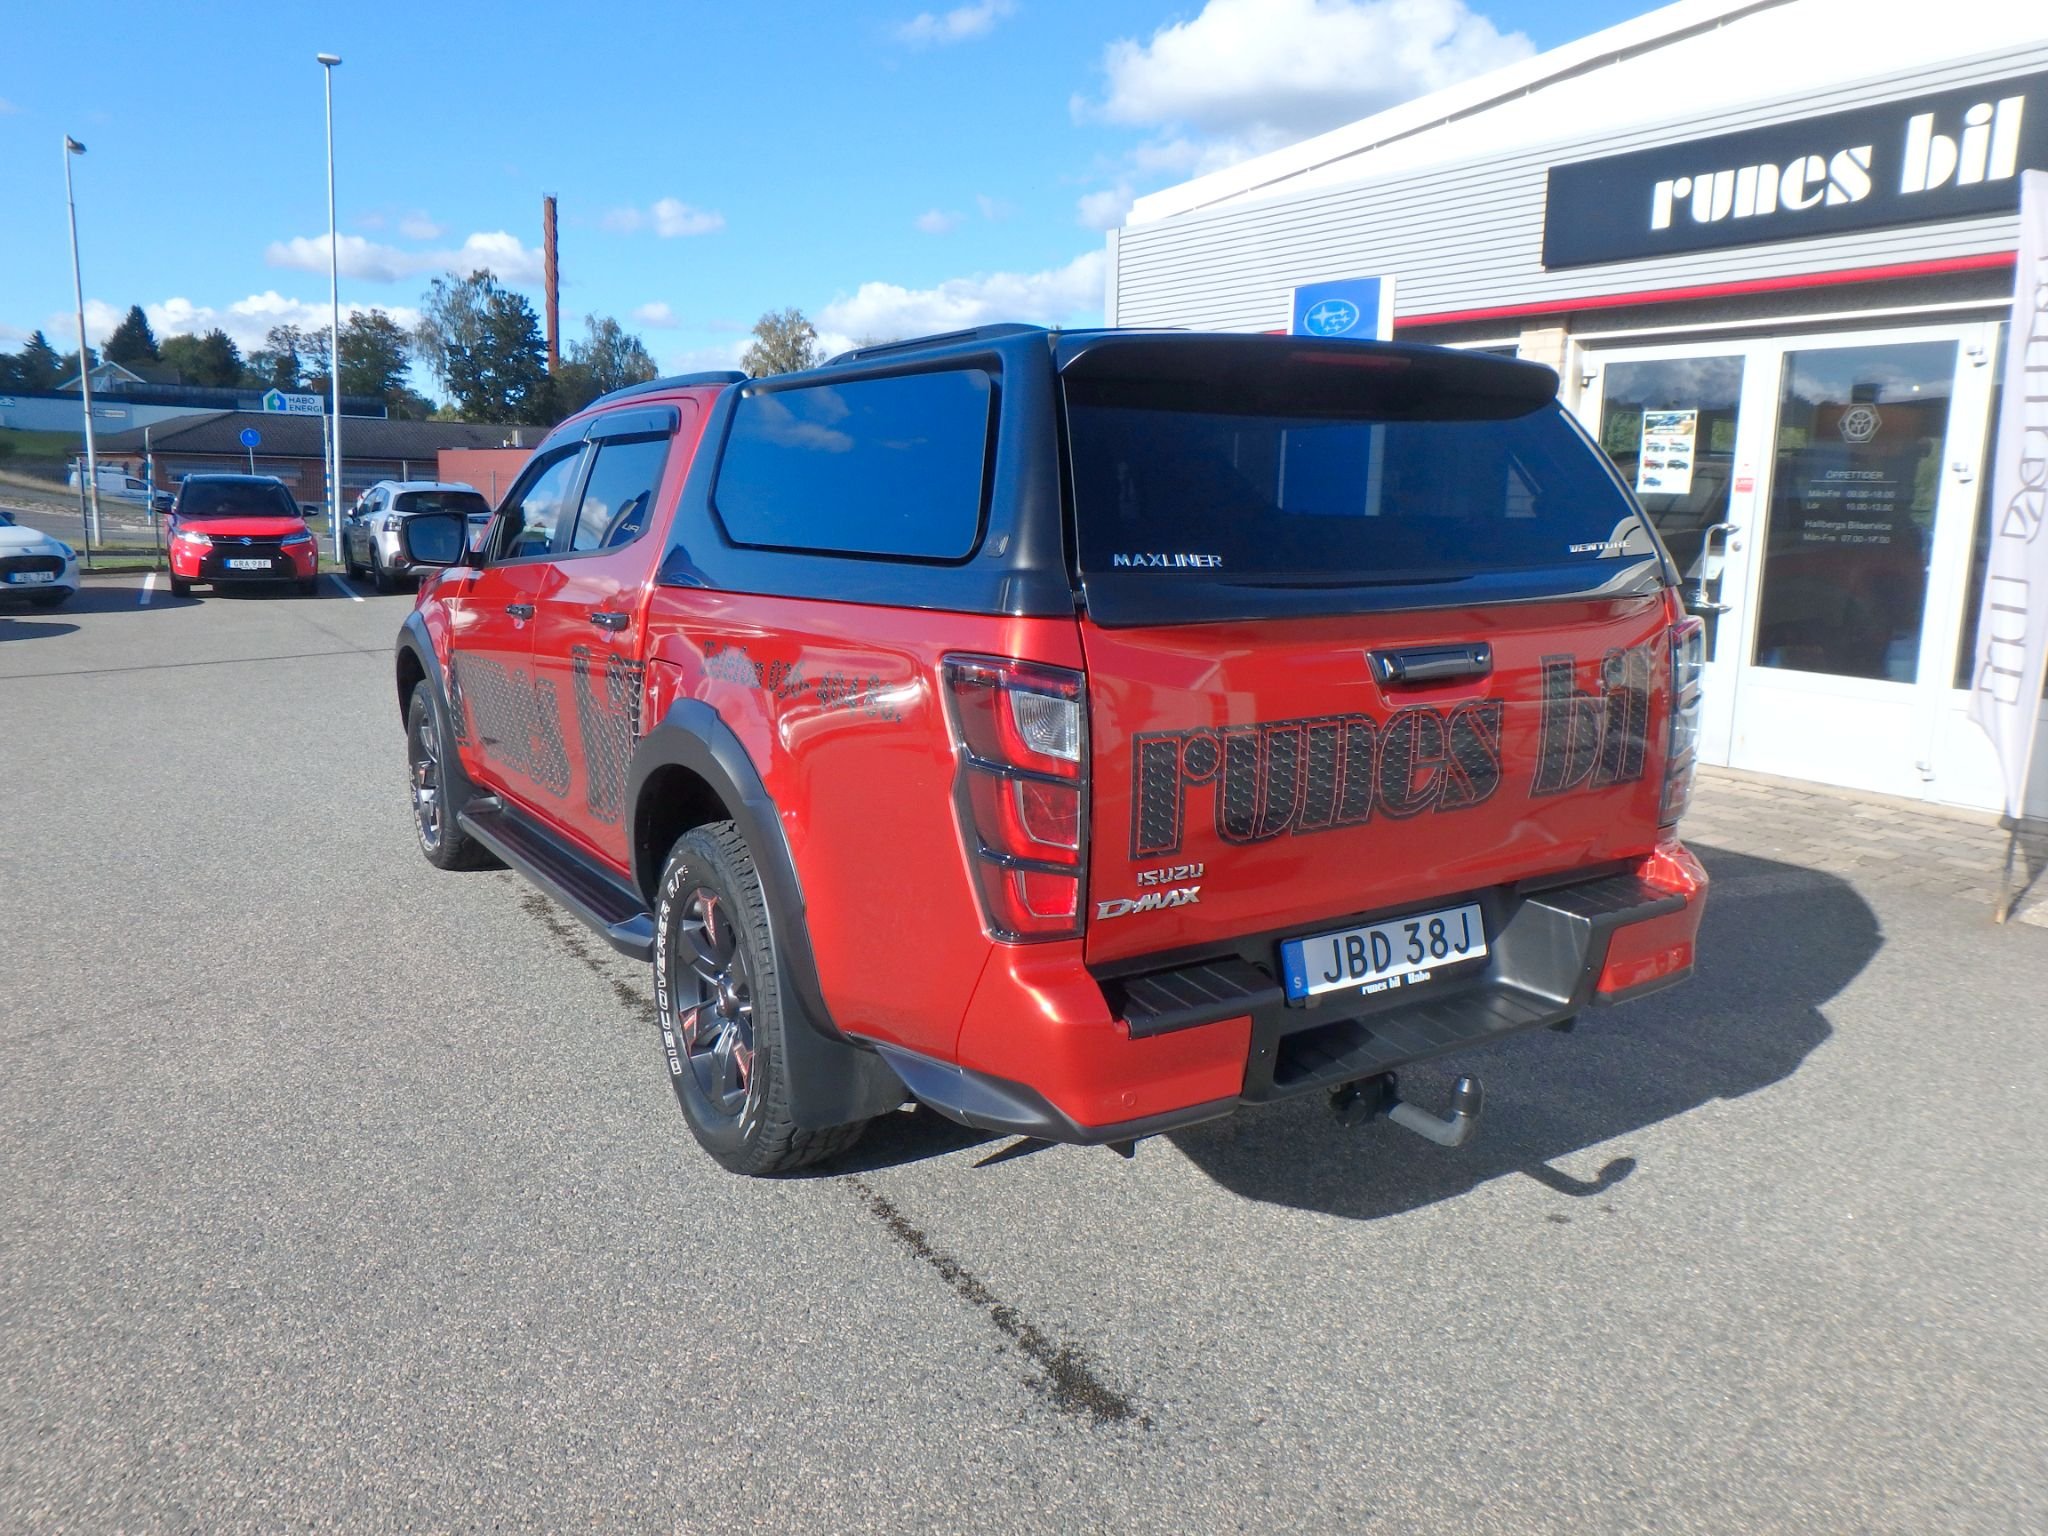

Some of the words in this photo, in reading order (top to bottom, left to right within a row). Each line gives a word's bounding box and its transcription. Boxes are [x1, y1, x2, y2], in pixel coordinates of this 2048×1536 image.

[1651, 145, 1873, 230] runes
[1900, 95, 2026, 194] bil
[1113, 553, 1223, 567] MAXLINER
[1569, 539, 1633, 553] VENTURE
[233, 560, 250, 568] GRA
[1129, 698, 1504, 861] runes
[1528, 645, 1650, 799] bil
[1137, 863, 1204, 887] ISUZU
[1096, 886, 1201, 920] D-MAX
[1293, 977, 1303, 989] S
[1323, 930, 1391, 984] JBD
[1403, 912, 1470, 964] 38J
[656, 900, 682, 1075] DISCOVERER
[1361, 981, 1388, 996] runes
[1388, 975, 1401, 989] bil
[1407, 970, 1431, 985] Habo
